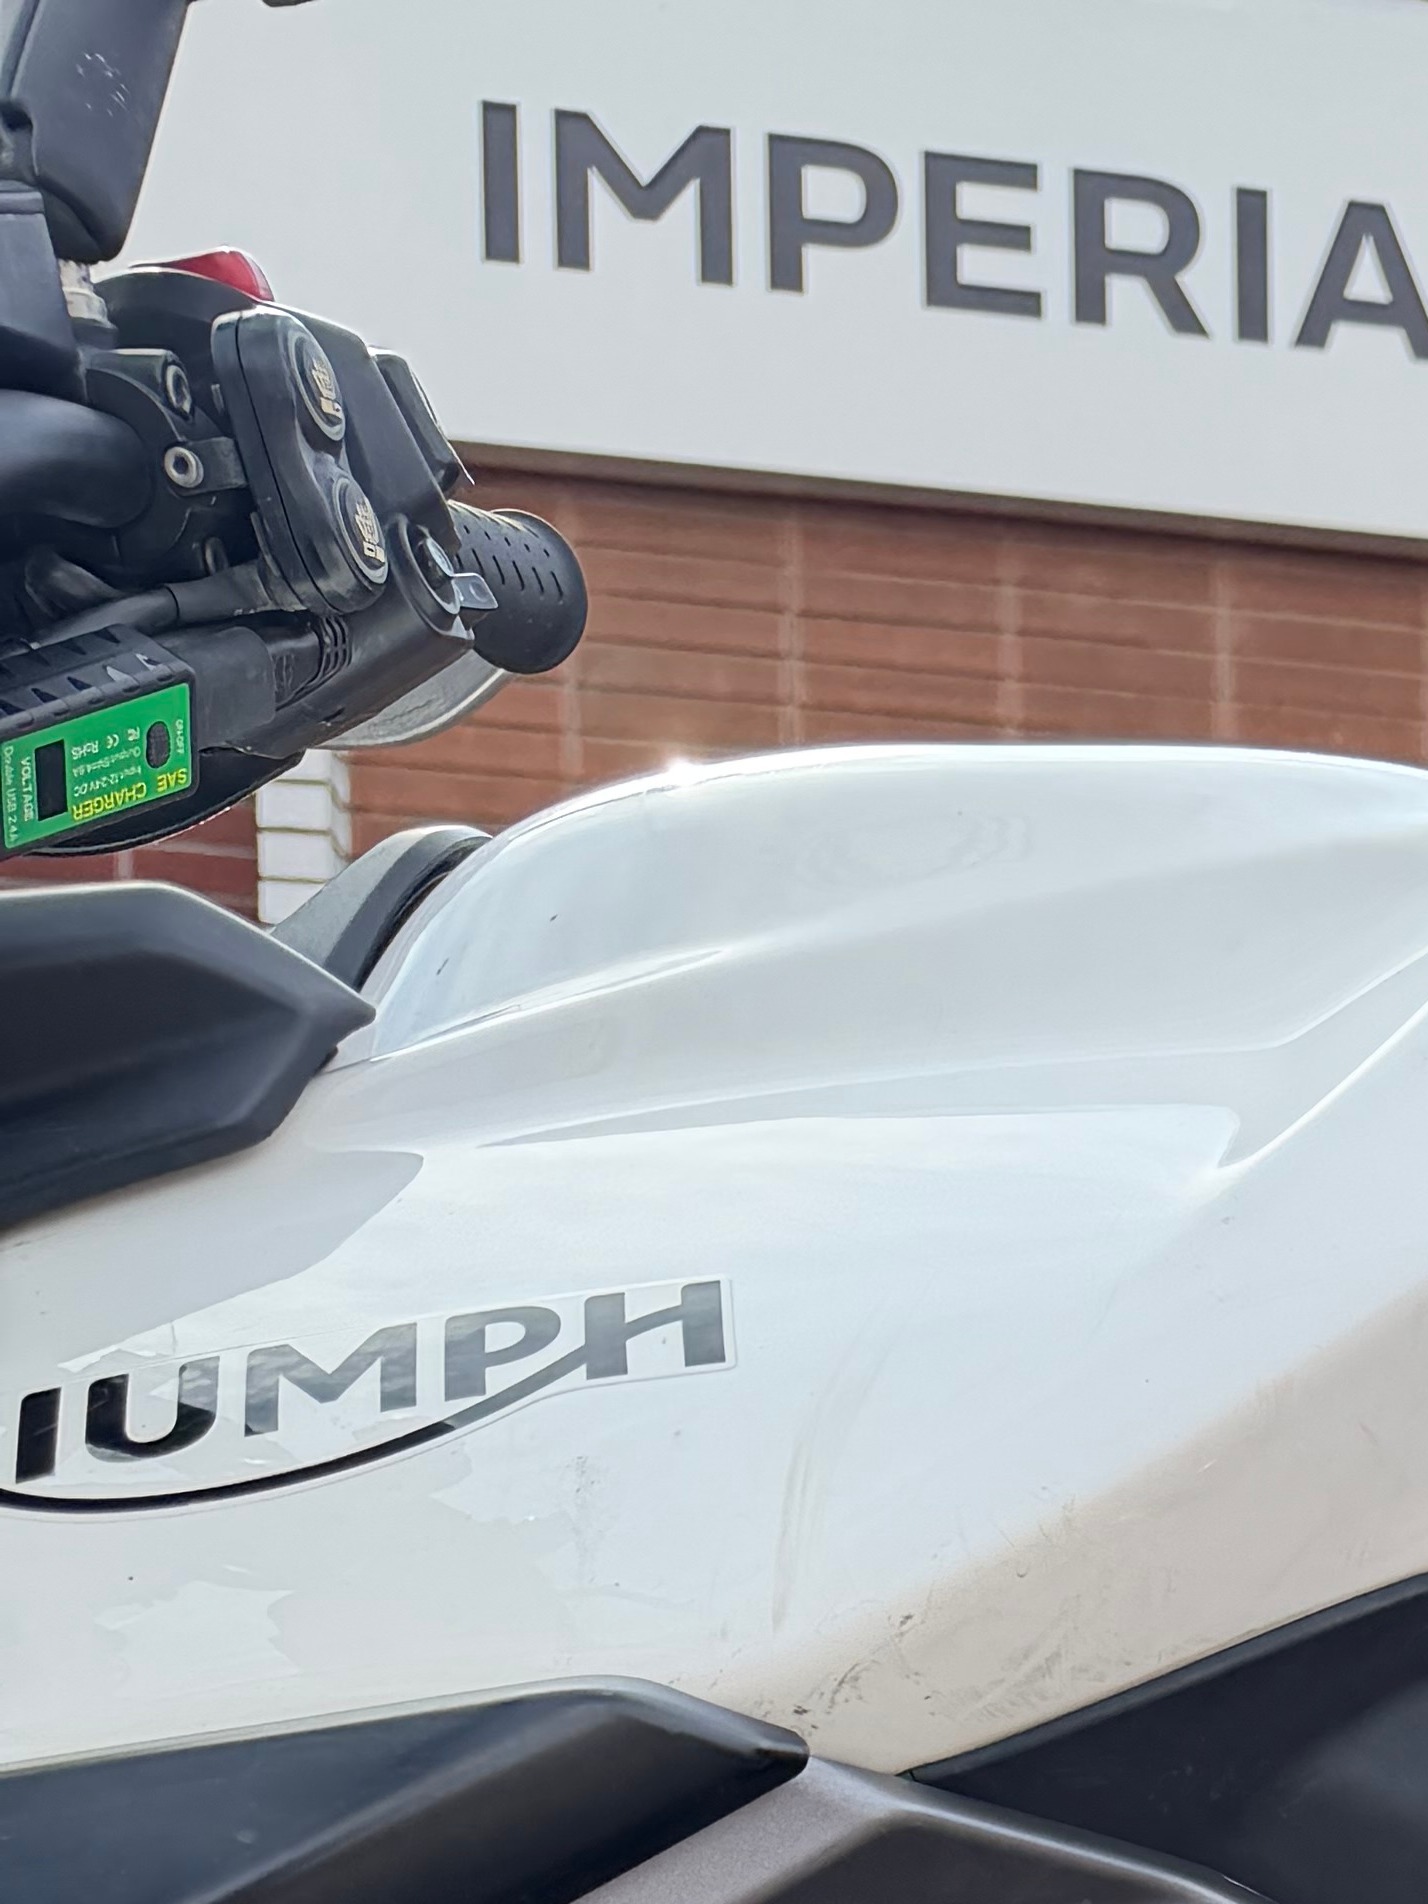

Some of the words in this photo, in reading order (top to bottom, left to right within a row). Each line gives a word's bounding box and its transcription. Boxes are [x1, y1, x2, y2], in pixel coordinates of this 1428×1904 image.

[20, 756, 35, 822] VOLTAGE
[156, 767, 188, 792] SAE
[71, 781, 147, 821] CHARGER
